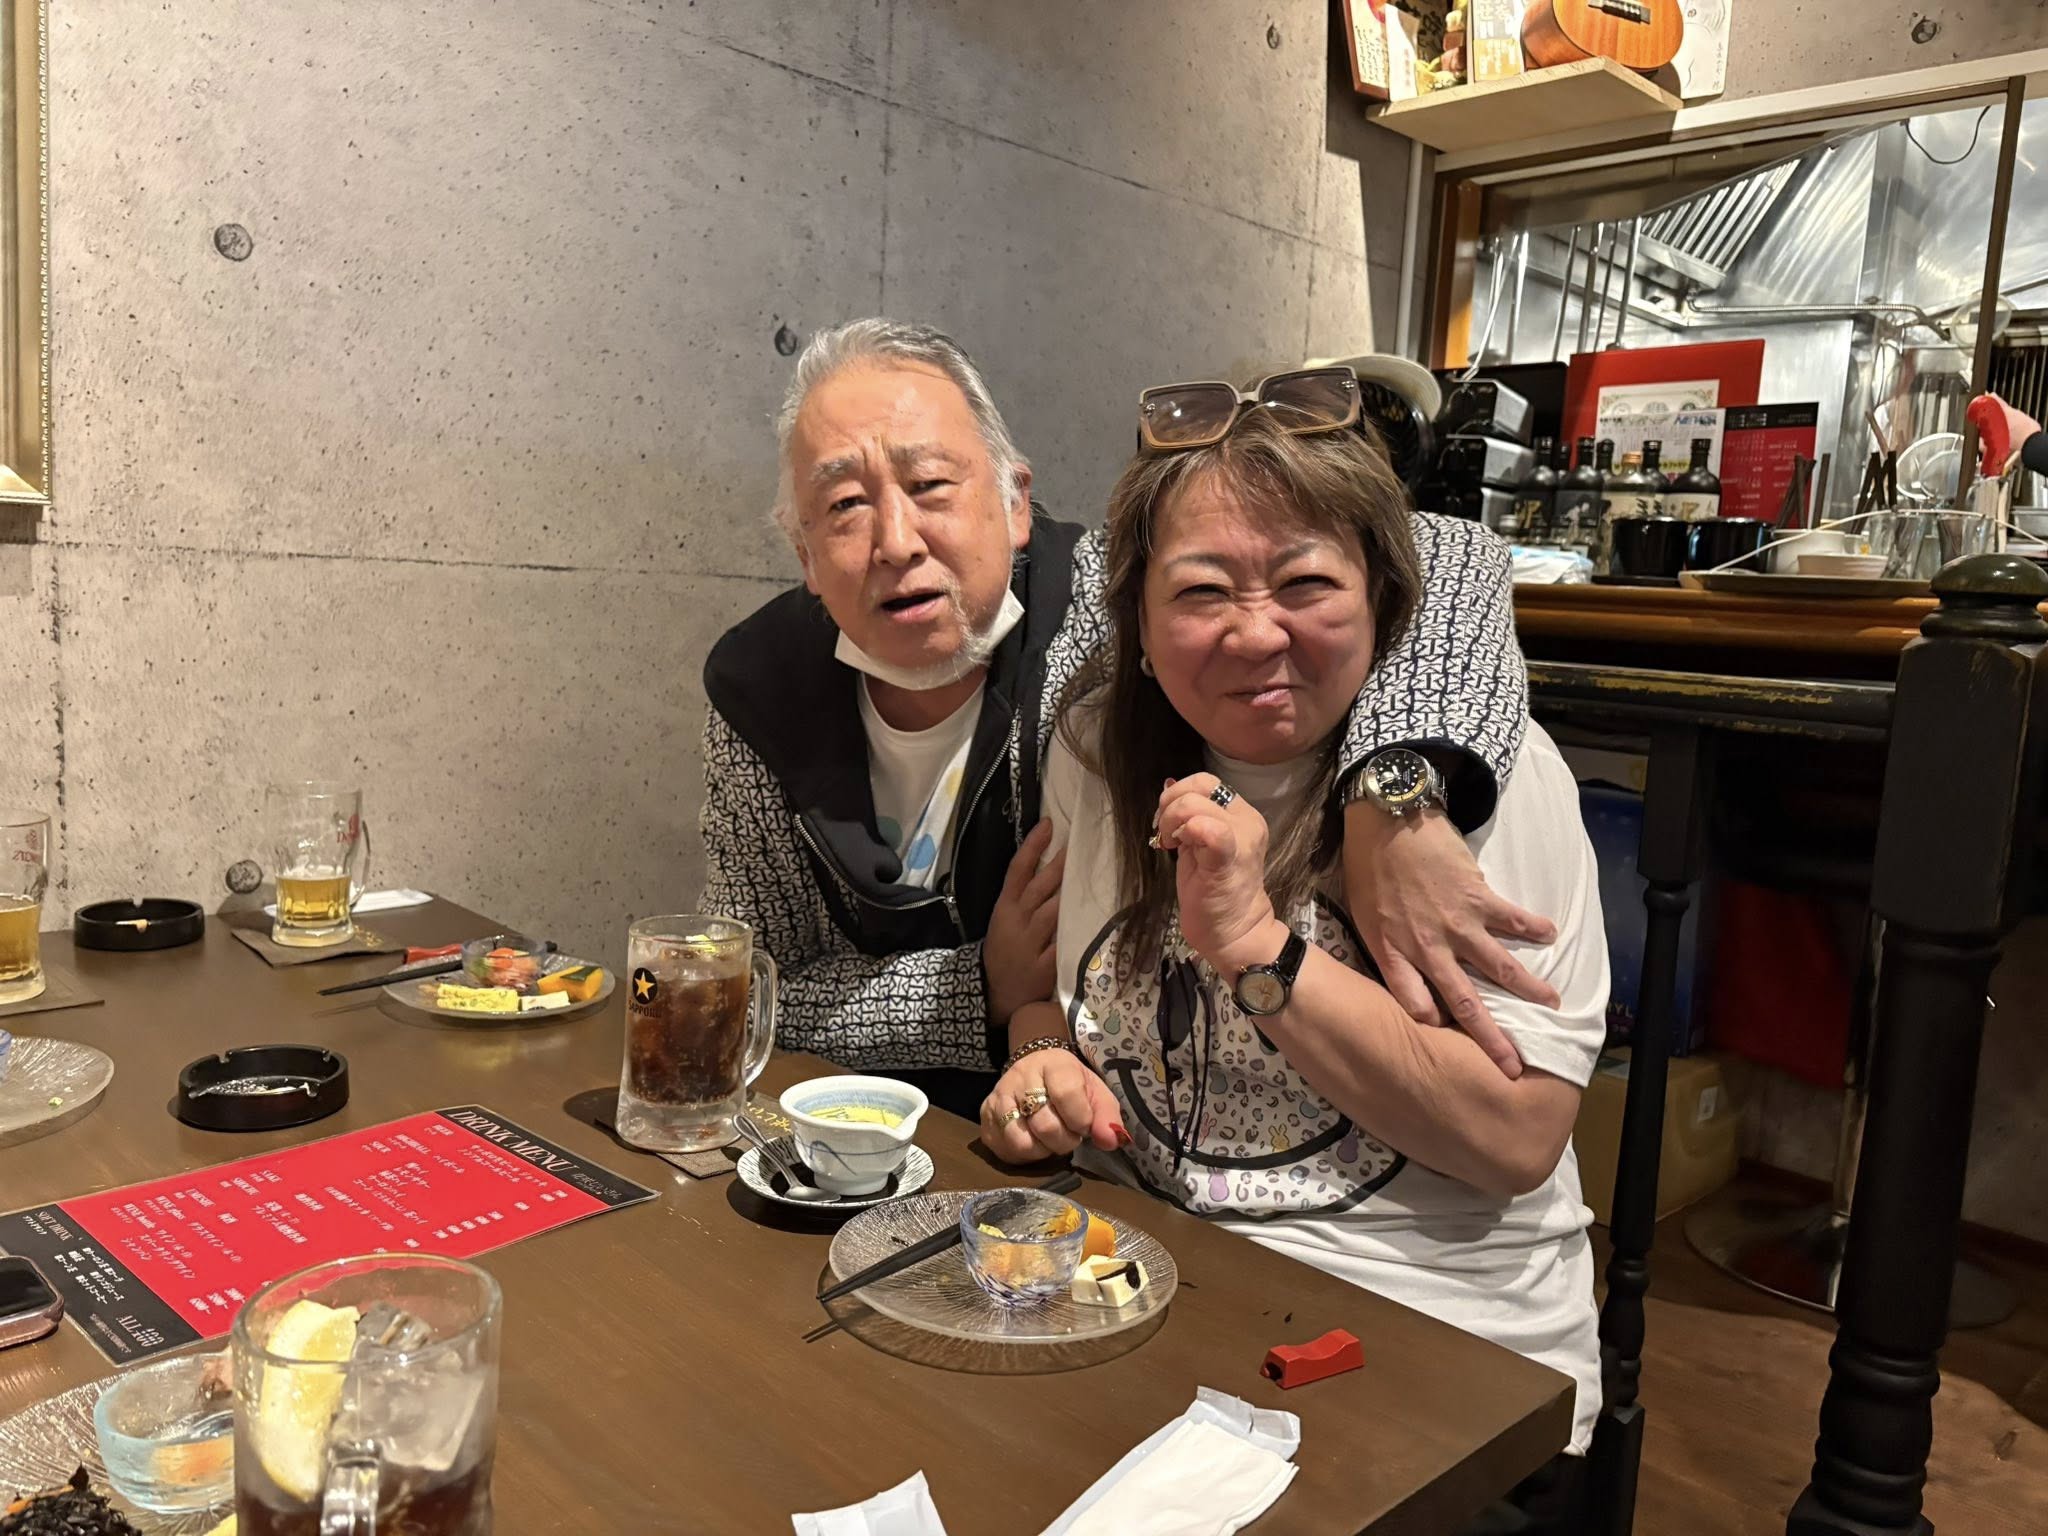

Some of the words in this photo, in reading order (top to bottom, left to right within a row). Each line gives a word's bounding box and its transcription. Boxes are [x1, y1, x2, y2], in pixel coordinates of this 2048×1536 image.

[447, 1110, 522, 1143] DRINK
[503, 1139, 580, 1172] MENU
[115, 1314, 143, 1333] ALL
